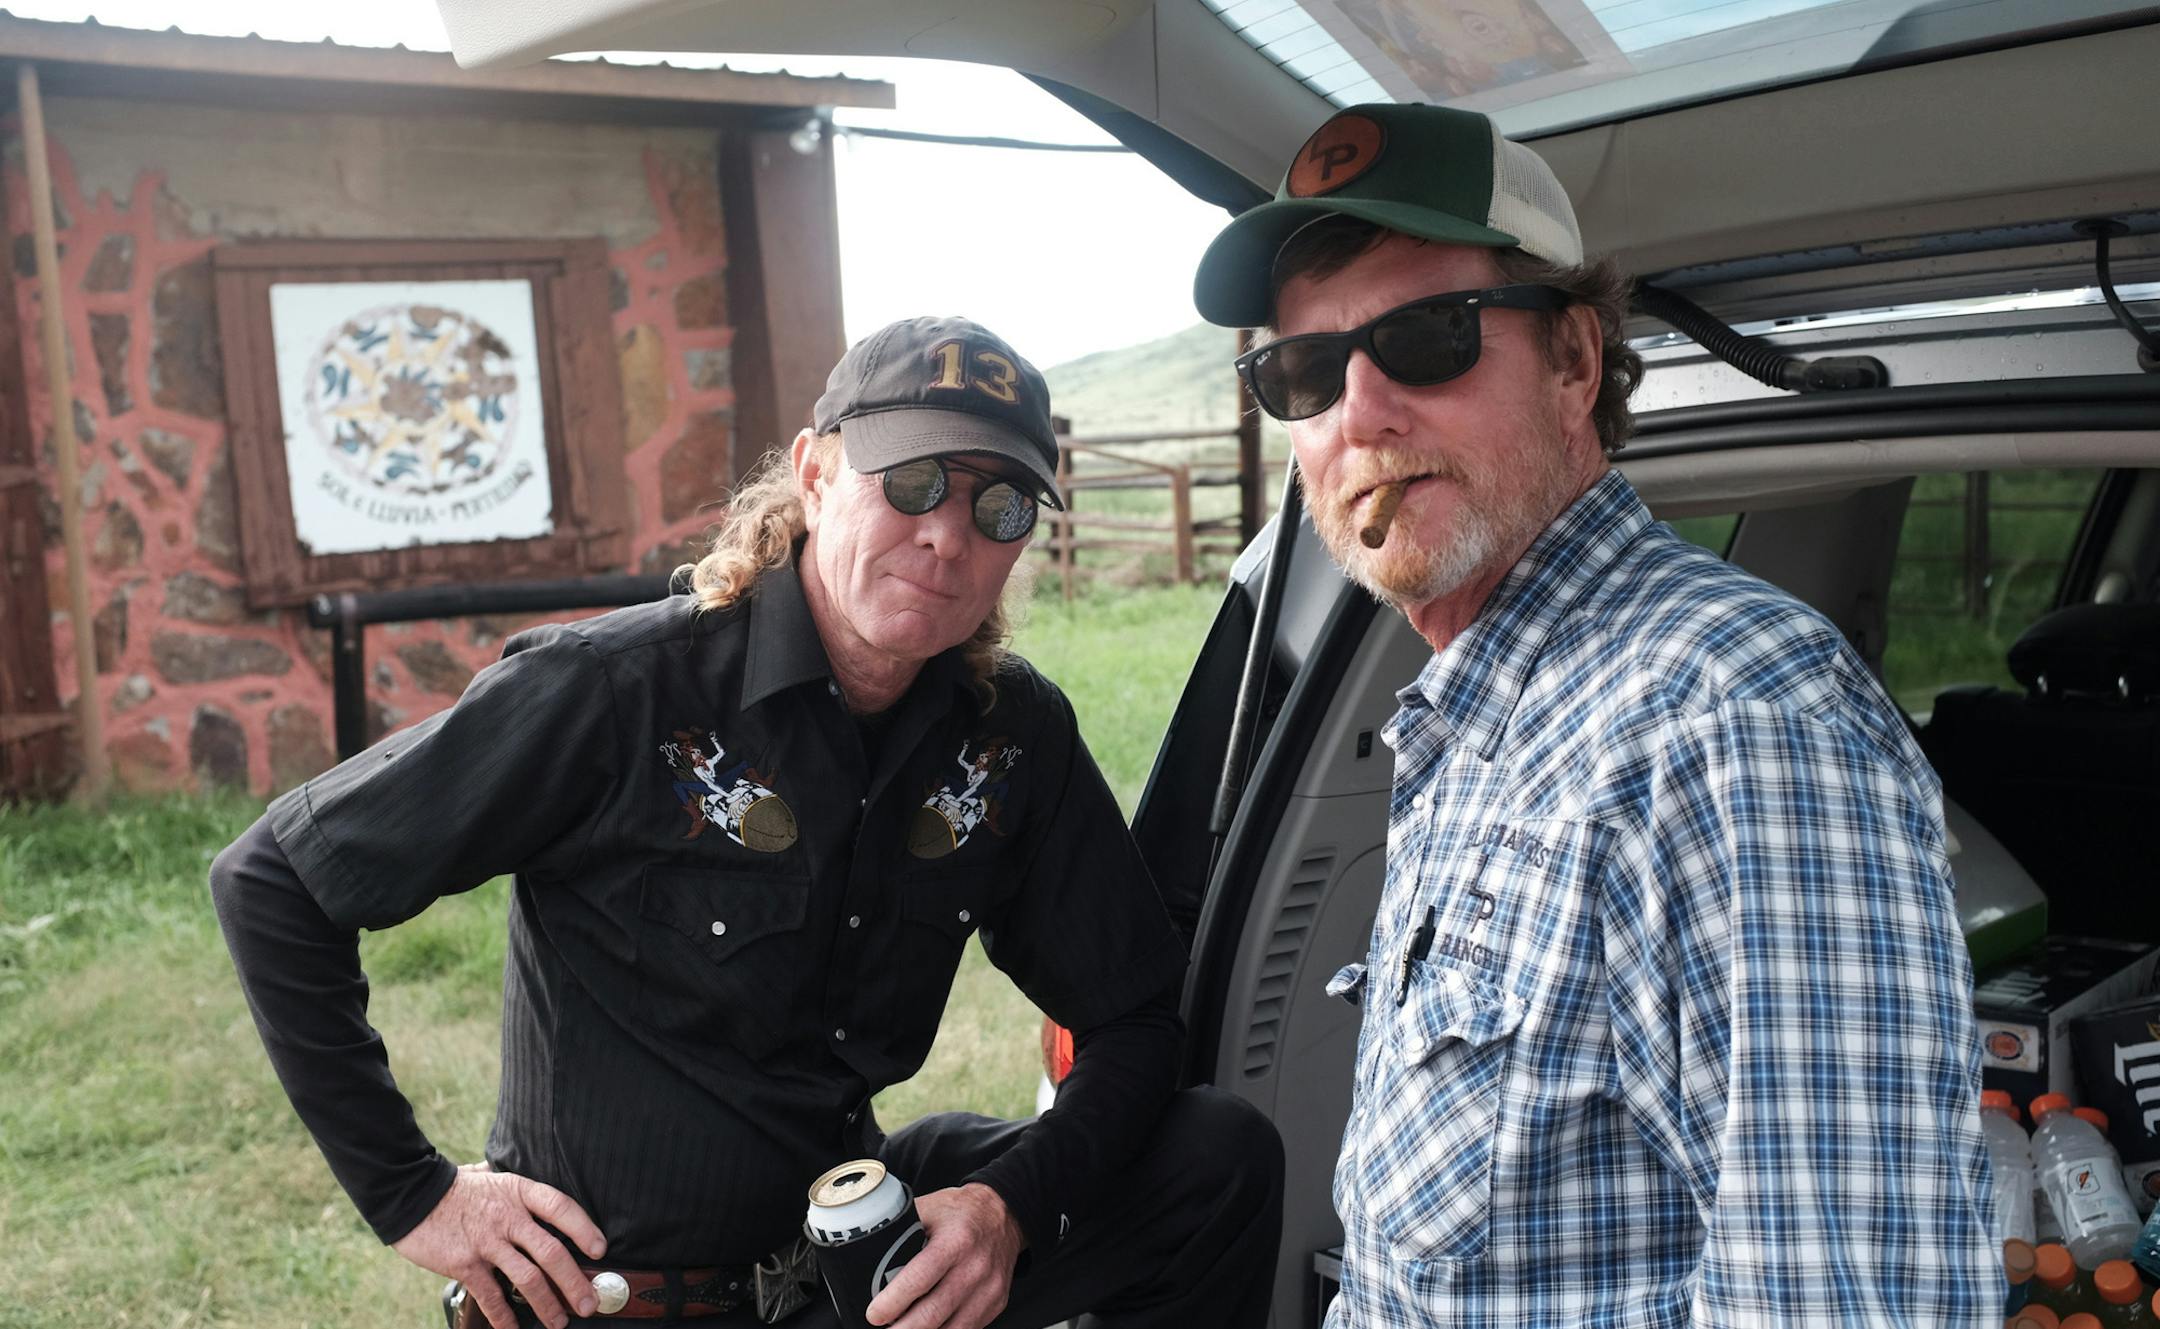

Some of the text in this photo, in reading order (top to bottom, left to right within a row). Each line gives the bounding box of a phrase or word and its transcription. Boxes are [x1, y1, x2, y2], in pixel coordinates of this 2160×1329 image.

[928, 338, 1020, 404] 13
[317, 471, 350, 504] SOL
[366, 498, 437, 524] LLUVIA
[1438, 934, 1494, 970] RANCH
